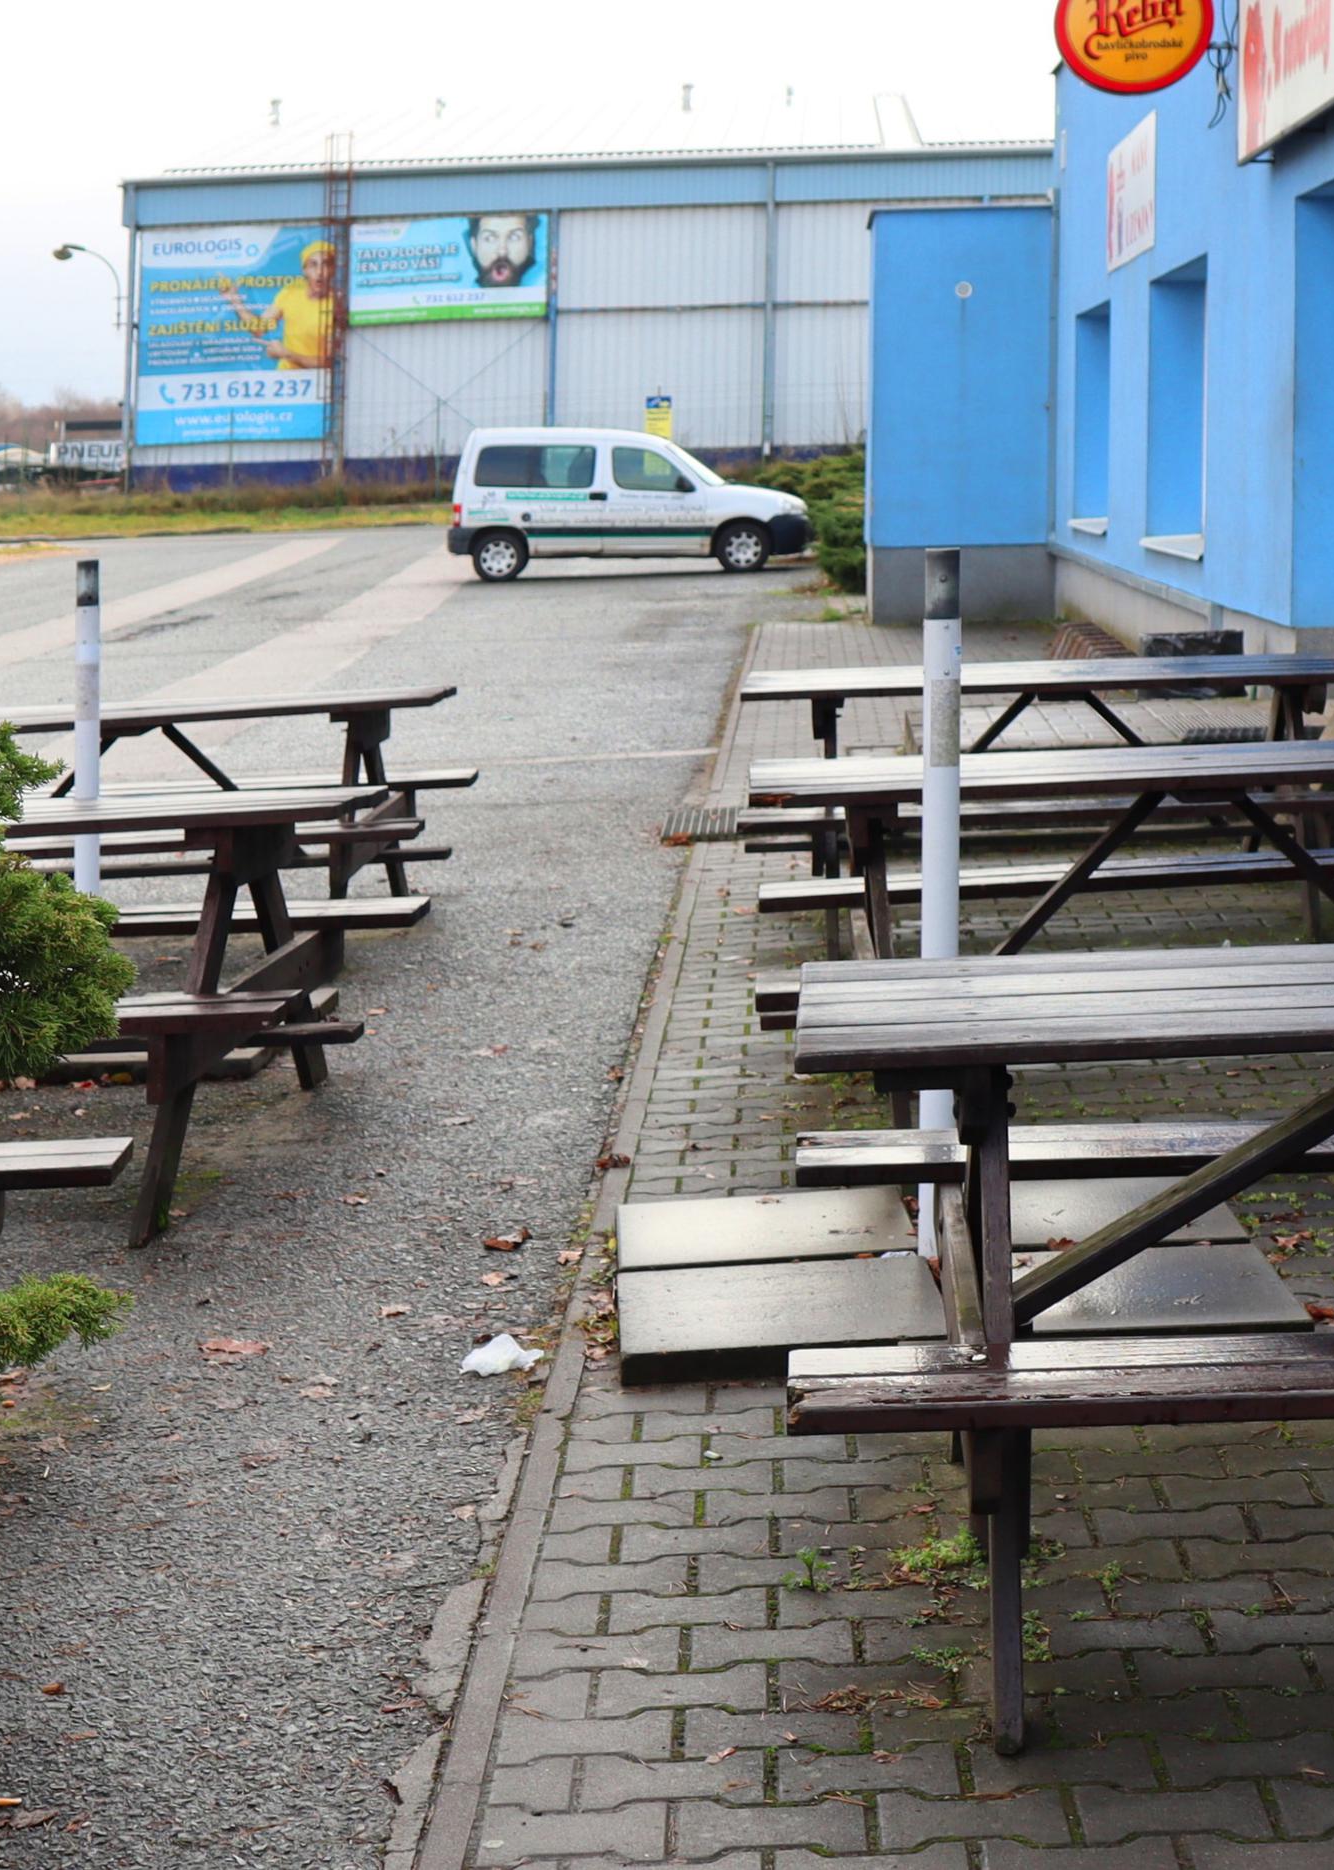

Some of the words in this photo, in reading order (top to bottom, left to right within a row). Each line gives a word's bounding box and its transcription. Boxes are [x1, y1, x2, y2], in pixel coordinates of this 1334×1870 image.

[1124, 50, 1148, 62] pivo
[153, 238, 242, 256] EUROLOGIS
[356, 247, 389, 260] TATO
[391, 244, 442, 258] PLOCHA
[444, 243, 458, 255] JE
[356, 260, 380, 273] JEN
[381, 259, 410, 272] PRO
[148, 319, 221, 337] ZAJIŠTĚNÍ
[224, 318, 278, 333] SLUŽEB
[182, 383, 220, 401] 731
[227, 380, 266, 399] 612
[273, 379, 312, 398] 237
